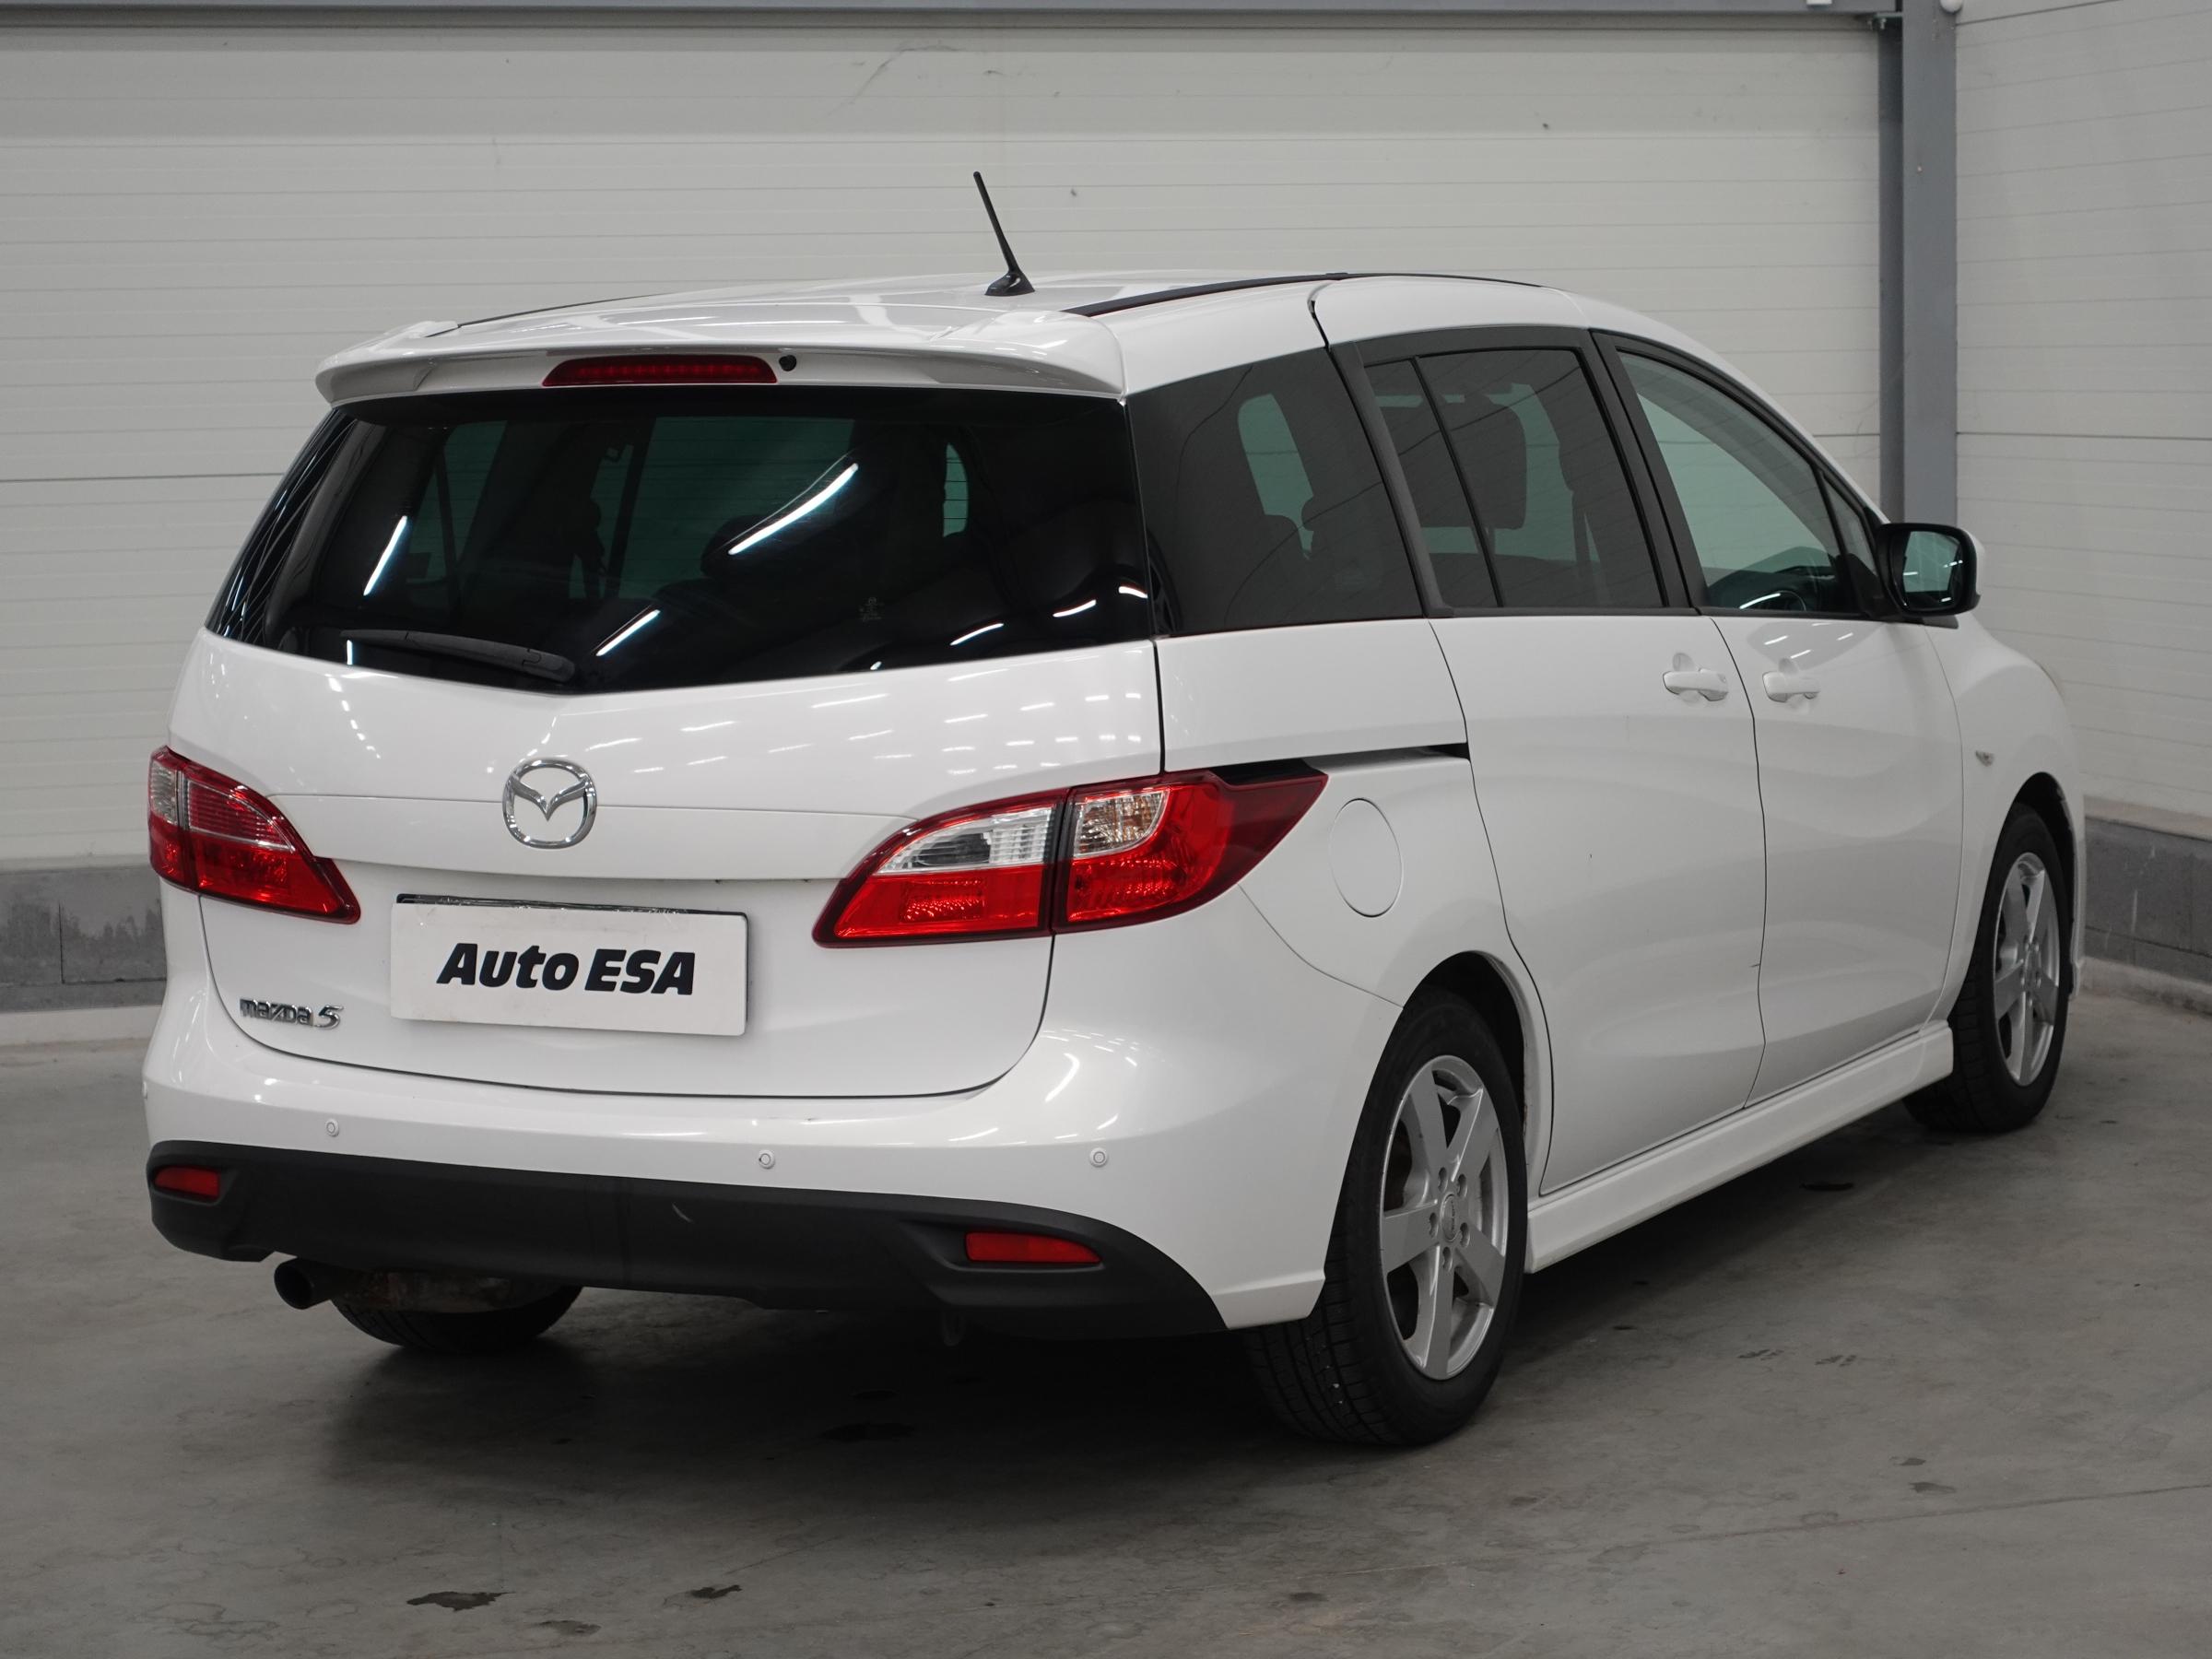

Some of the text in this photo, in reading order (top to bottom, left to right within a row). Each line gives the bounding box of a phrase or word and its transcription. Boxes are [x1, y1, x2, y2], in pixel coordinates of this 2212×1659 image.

[436, 942, 696, 995] Auto ESA
[240, 997, 344, 1030] mazda 5
